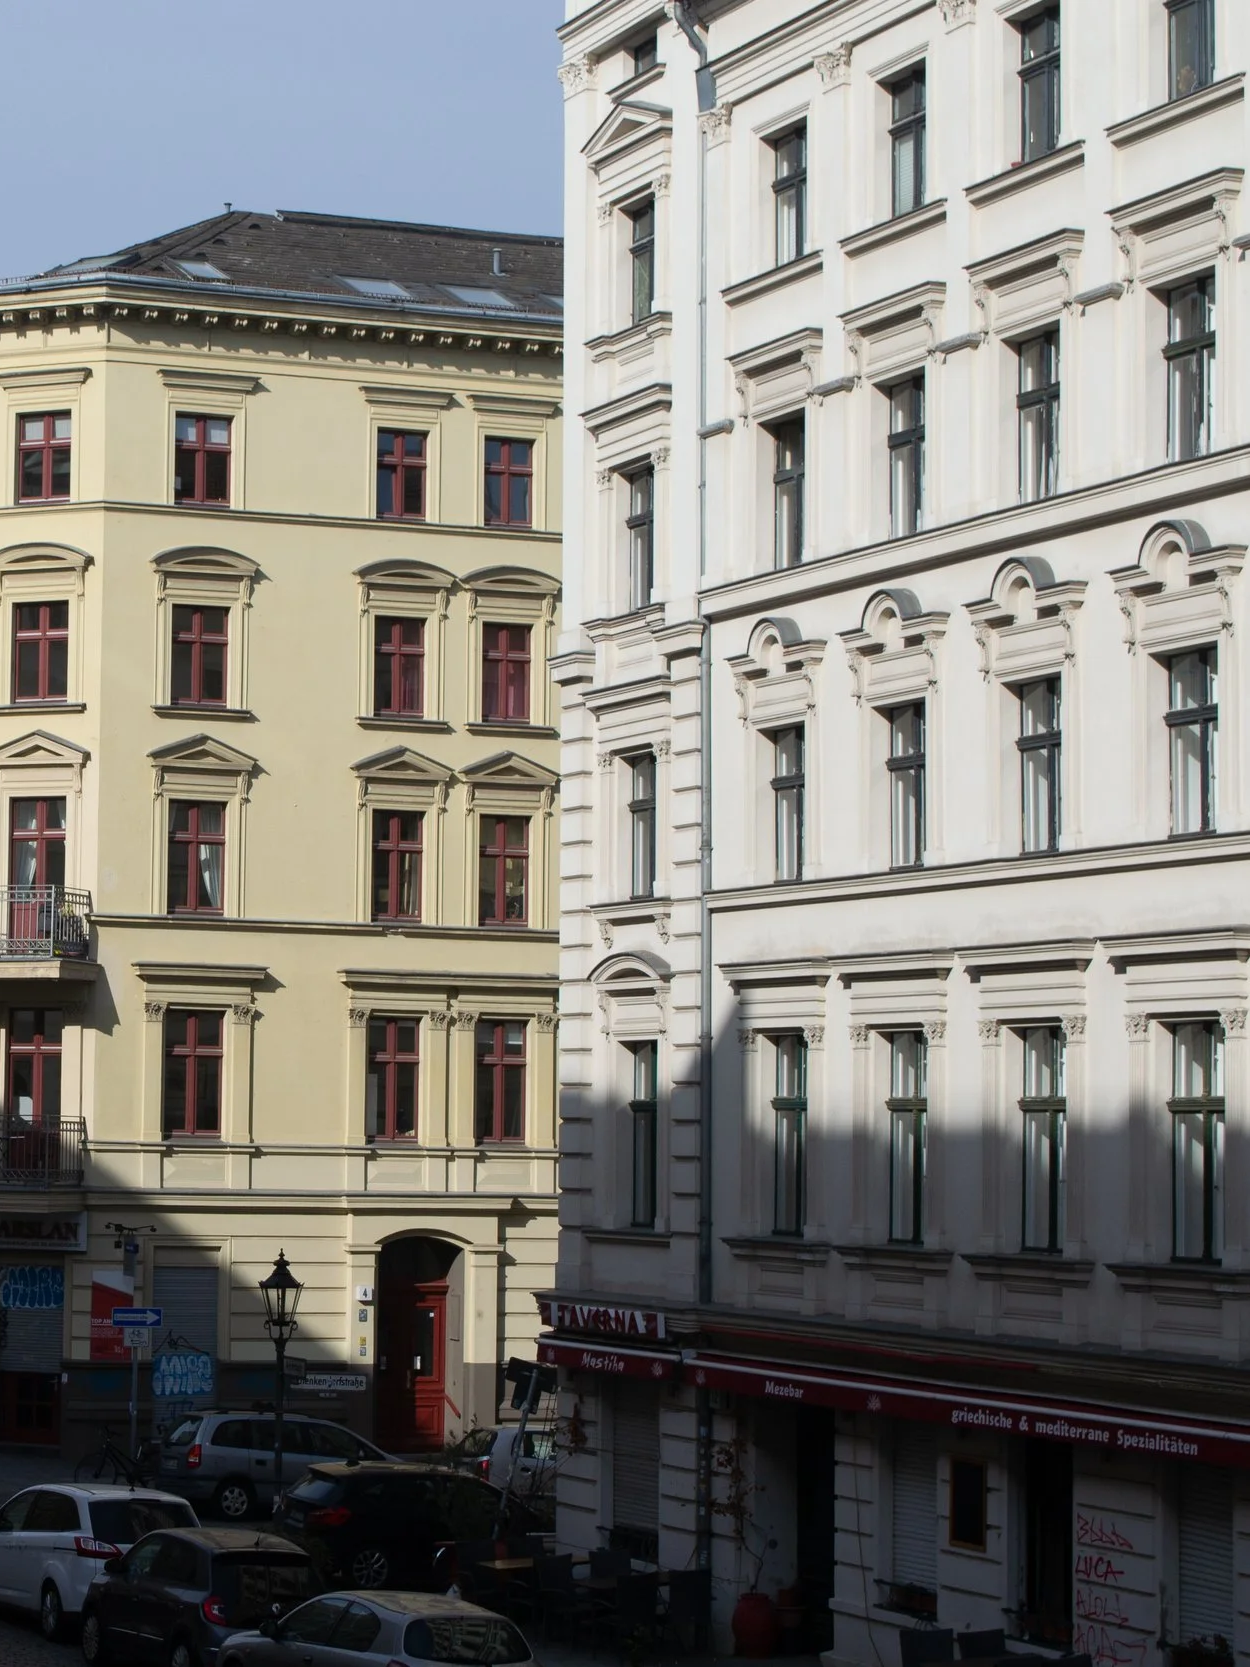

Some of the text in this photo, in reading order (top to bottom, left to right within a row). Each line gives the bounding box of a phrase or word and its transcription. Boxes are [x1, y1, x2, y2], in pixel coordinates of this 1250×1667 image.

[363, 1288, 367, 1298] 4
[558, 1303, 646, 1335] TAVERNA
[582, 1352, 625, 1372] Mastiha
[765, 1380, 804, 1398] Mezebar
[951, 1406, 1199, 1456] griechische & mediterrane Spezialitäten
[1075, 1555, 1124, 1584] LUCA
